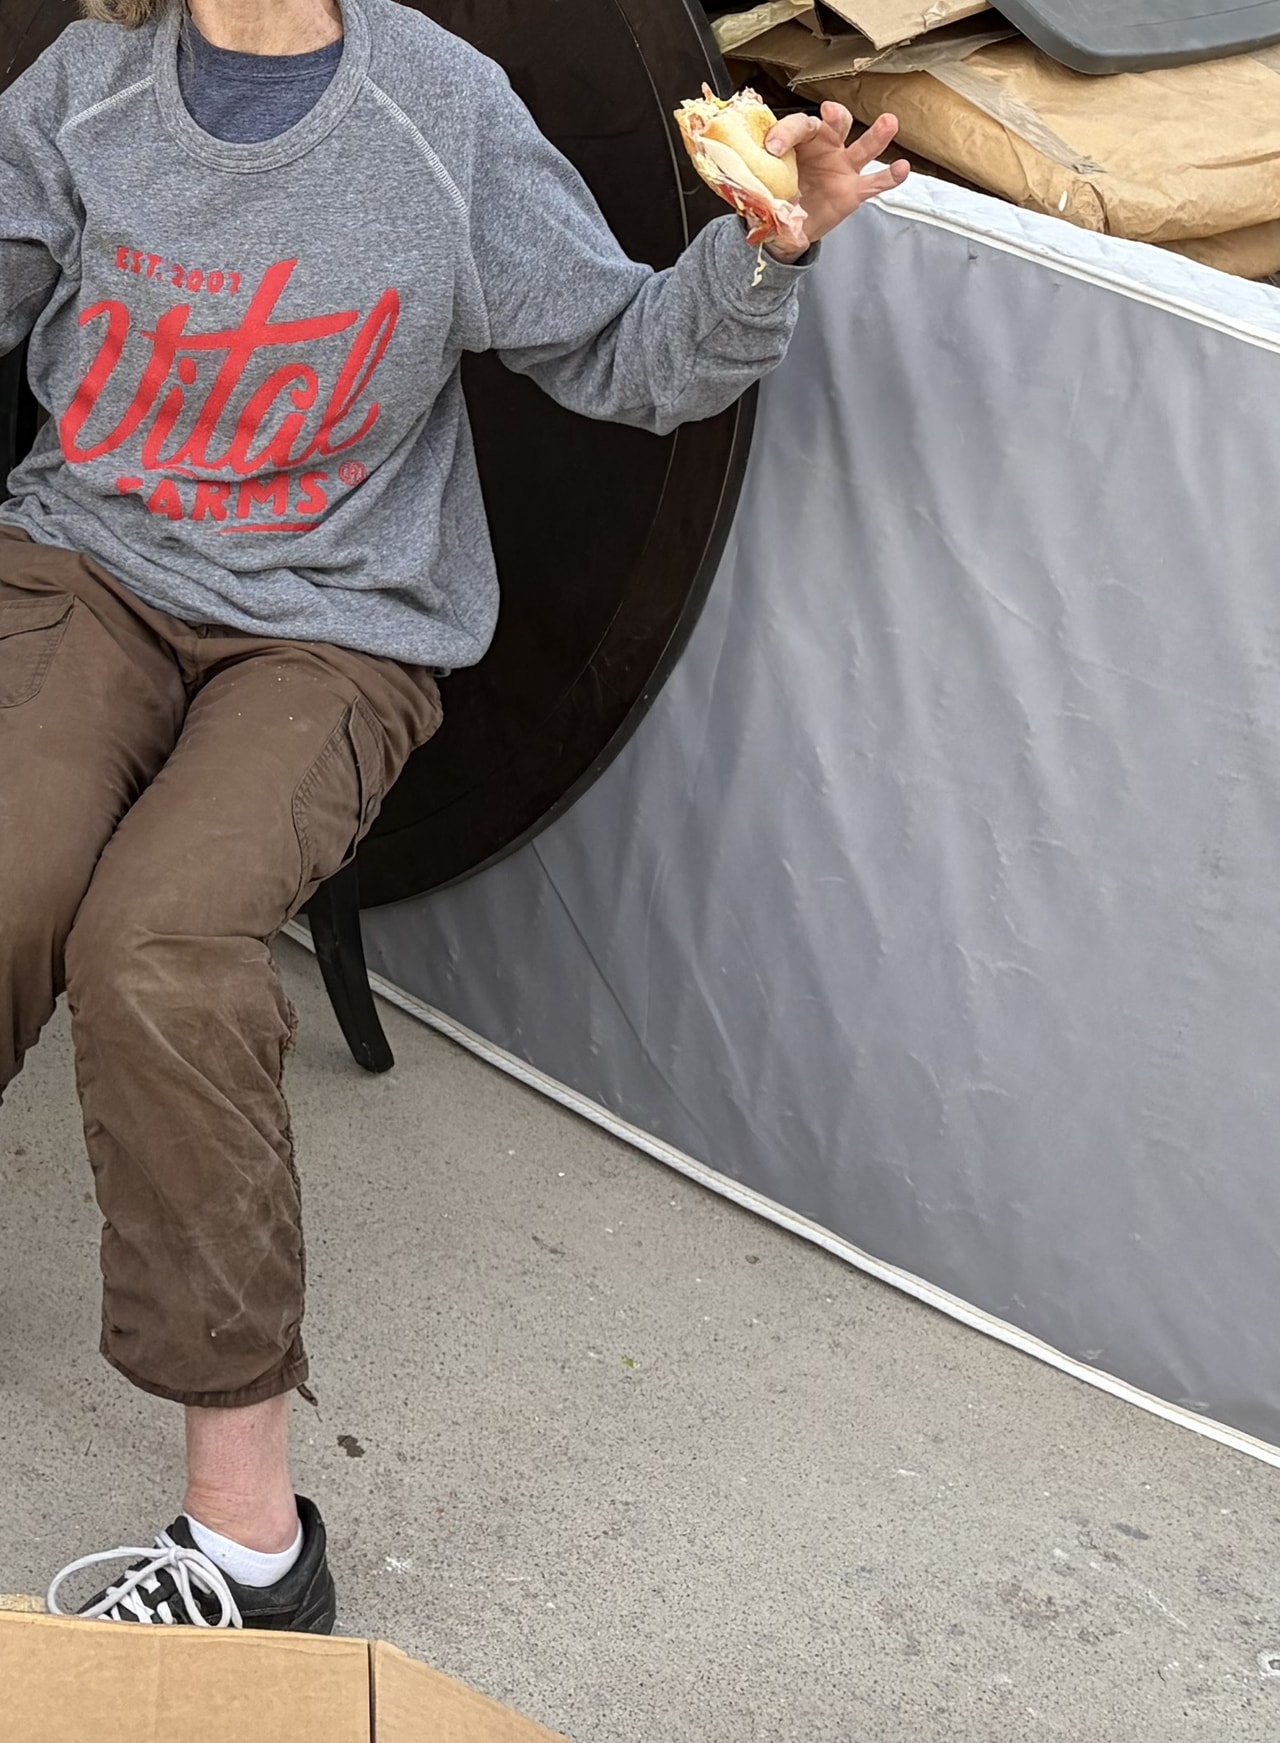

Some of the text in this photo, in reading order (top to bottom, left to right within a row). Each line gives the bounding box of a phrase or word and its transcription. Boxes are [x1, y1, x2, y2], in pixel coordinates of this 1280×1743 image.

[115, 246, 242, 296] EST. 2007
[59, 257, 401, 475] Vital
